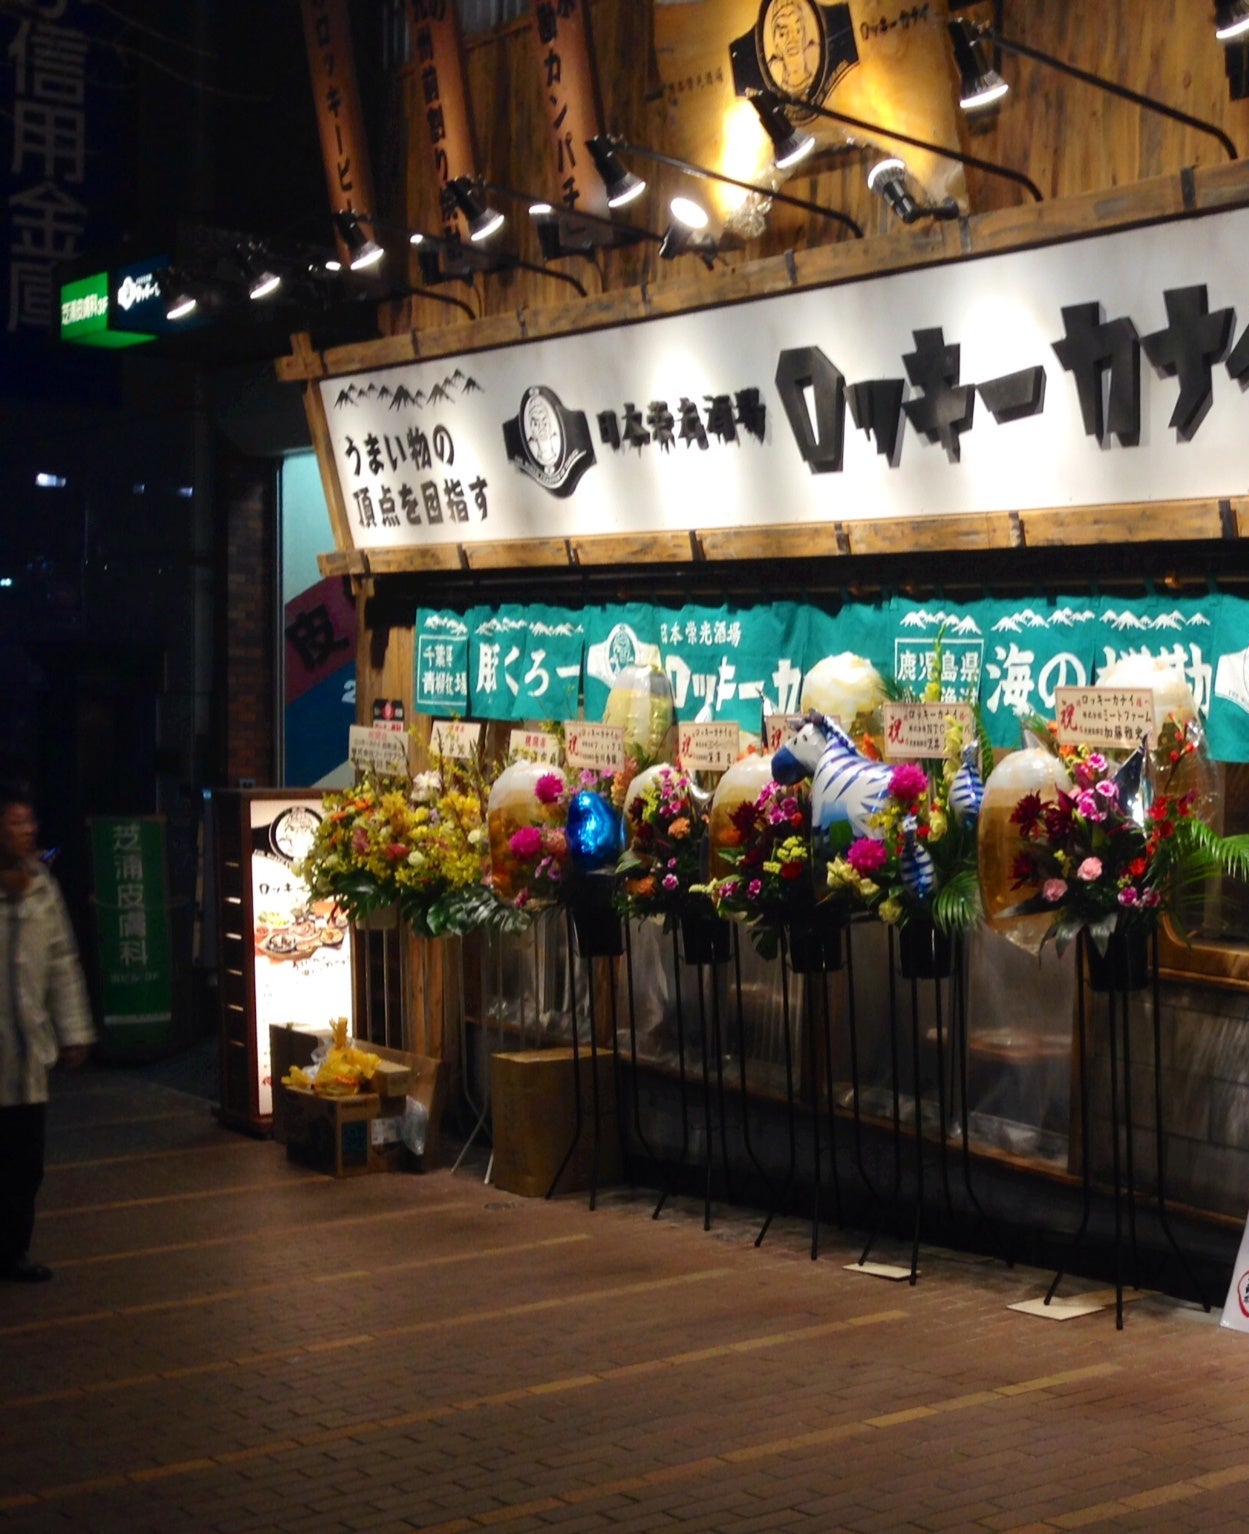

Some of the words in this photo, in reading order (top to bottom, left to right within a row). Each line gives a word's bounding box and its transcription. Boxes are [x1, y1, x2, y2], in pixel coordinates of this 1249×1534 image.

[344, 425, 454, 477] うまい物の
[353, 476, 489, 527] 頂点を目指す
[661, 620, 742, 648] 日本栄光酒場
[898, 650, 979, 682] 鹿児島県
[888, 715, 904, 744] 祝
[1060, 698, 1078, 732] 祝
